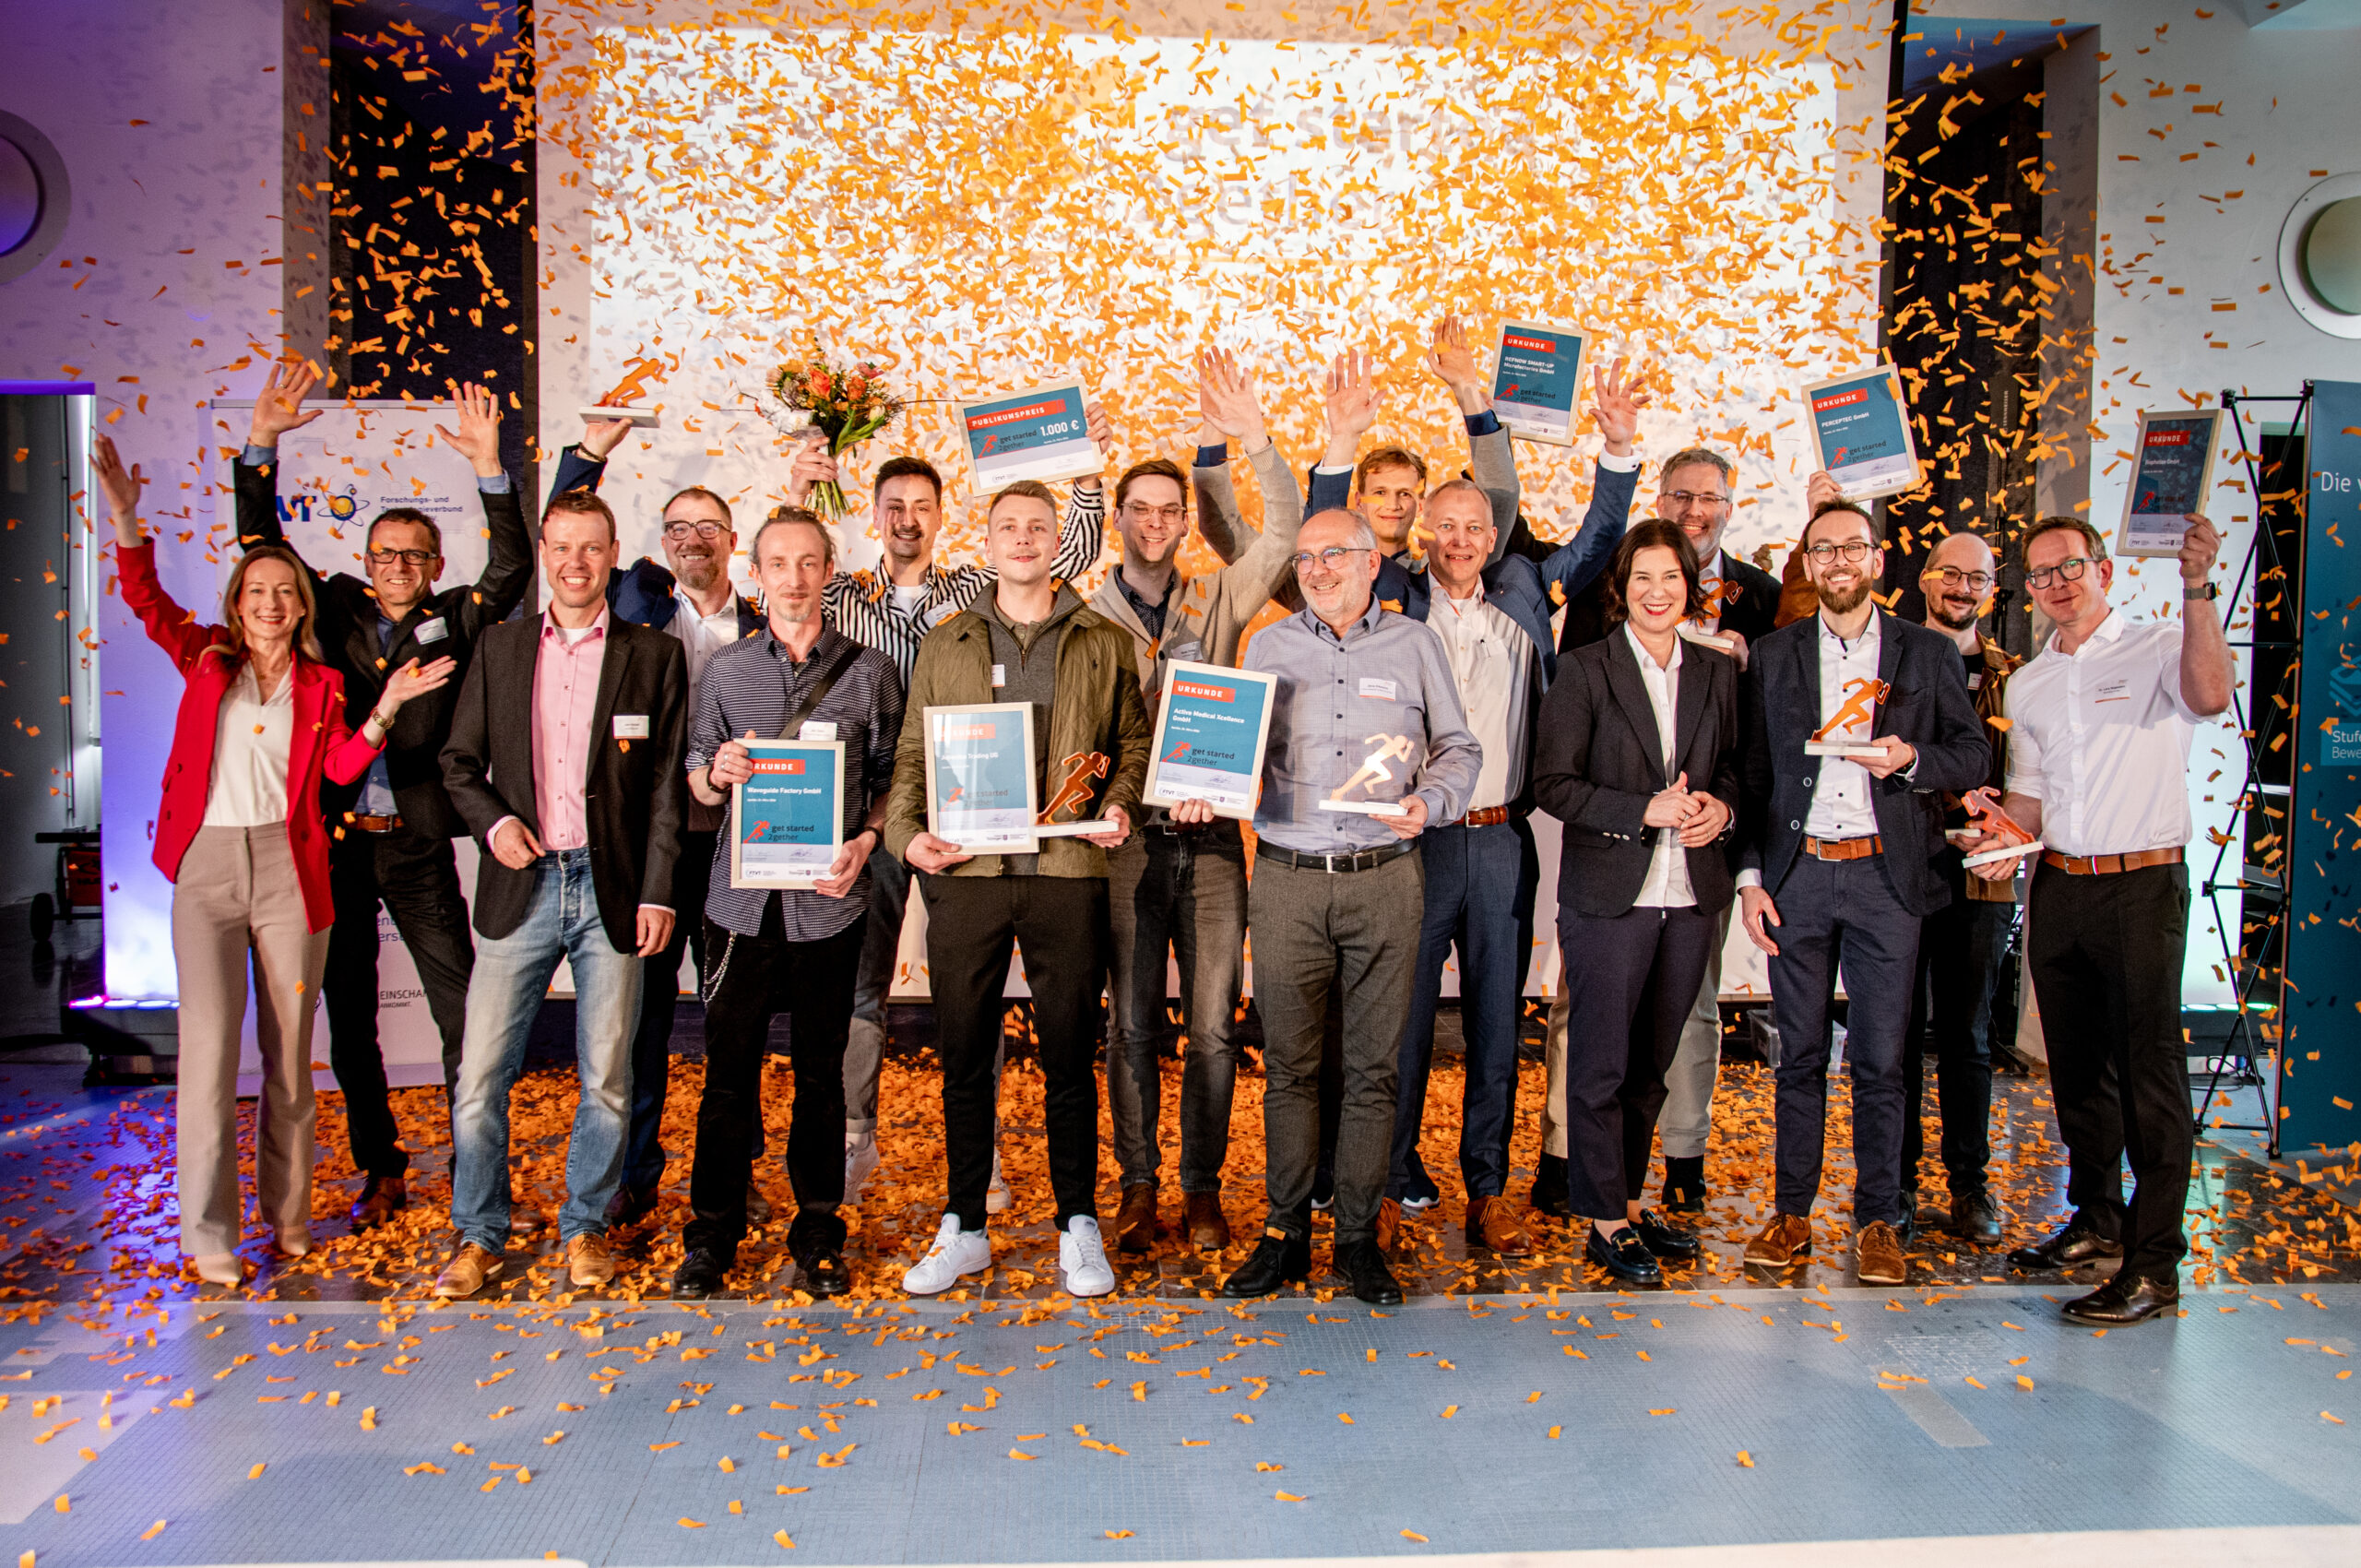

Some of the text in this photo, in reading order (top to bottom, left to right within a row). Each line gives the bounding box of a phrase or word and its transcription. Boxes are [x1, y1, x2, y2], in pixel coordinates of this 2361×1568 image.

[1507, 338, 1546, 350] URKUNDE
[1817, 394, 1857, 409] URKUNDE
[971, 406, 1046, 427] PUBLIKUMSPREIS
[1821, 411, 1869, 428] PERCEPTEC GmbH
[1040, 420, 1080, 437] 1.000 €
[999, 435, 1012, 445] get
[1013, 430, 1038, 442] started
[2149, 434, 2181, 443] URKUNDE
[1849, 441, 1887, 456] get started
[2321, 471, 2352, 493] Die
[380, 496, 432, 505] Forschungs-
[1177, 684, 1224, 698] URKUNDE
[1172, 715, 1192, 724] GmbH
[1173, 707, 1192, 717] Active
[1192, 710, 1216, 720] Medical
[1192, 747, 1235, 760] get started
[1187, 755, 1218, 766] 2gether
[751, 763, 794, 772] RKUNDE
[779, 788, 802, 796] Factory
[981, 789, 1009, 798] started
[771, 825, 814, 834] get started
[768, 833, 800, 842] 2gether
